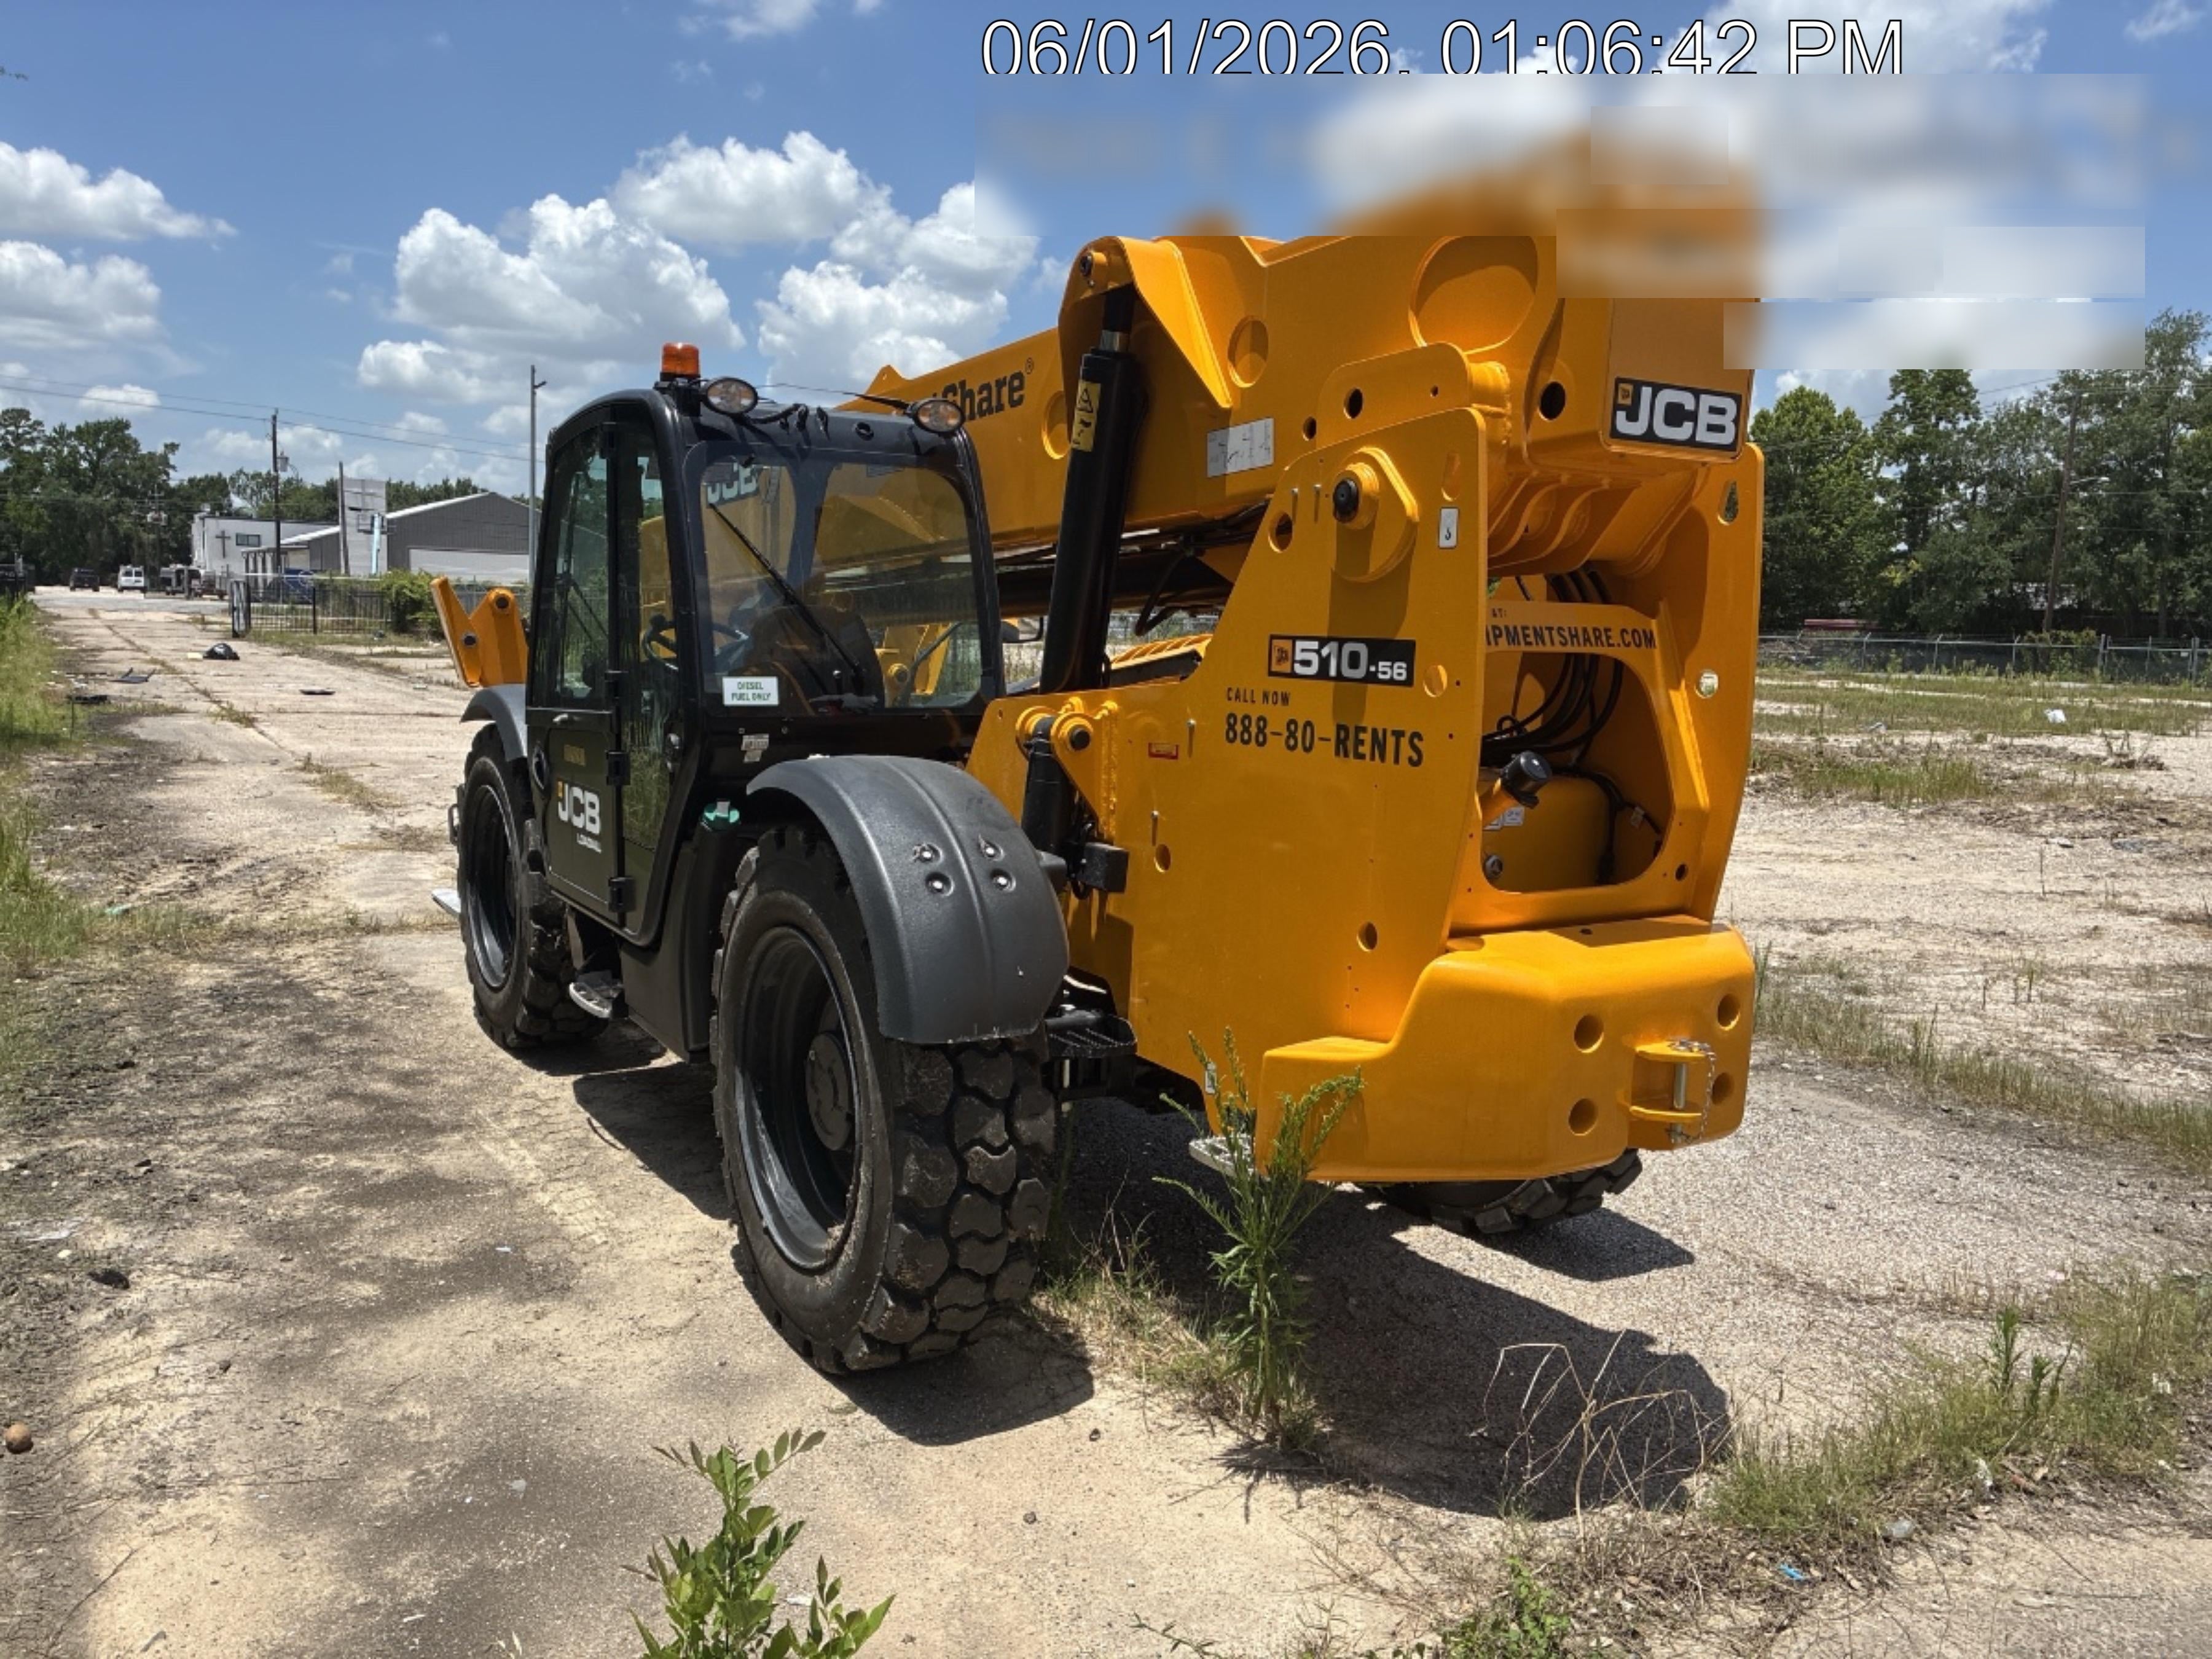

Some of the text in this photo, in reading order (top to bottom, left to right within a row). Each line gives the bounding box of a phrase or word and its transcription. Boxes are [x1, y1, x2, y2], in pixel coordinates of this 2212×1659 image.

[1616, 386, 1737, 445] JCB
[732, 692, 771, 701] FUEL ONLY
[737, 681, 763, 690] DIESEL
[1227, 687, 1290, 707] CALL NOW
[1225, 712, 1424, 767] 888-80-RENTS
[558, 783, 600, 834] JCB
